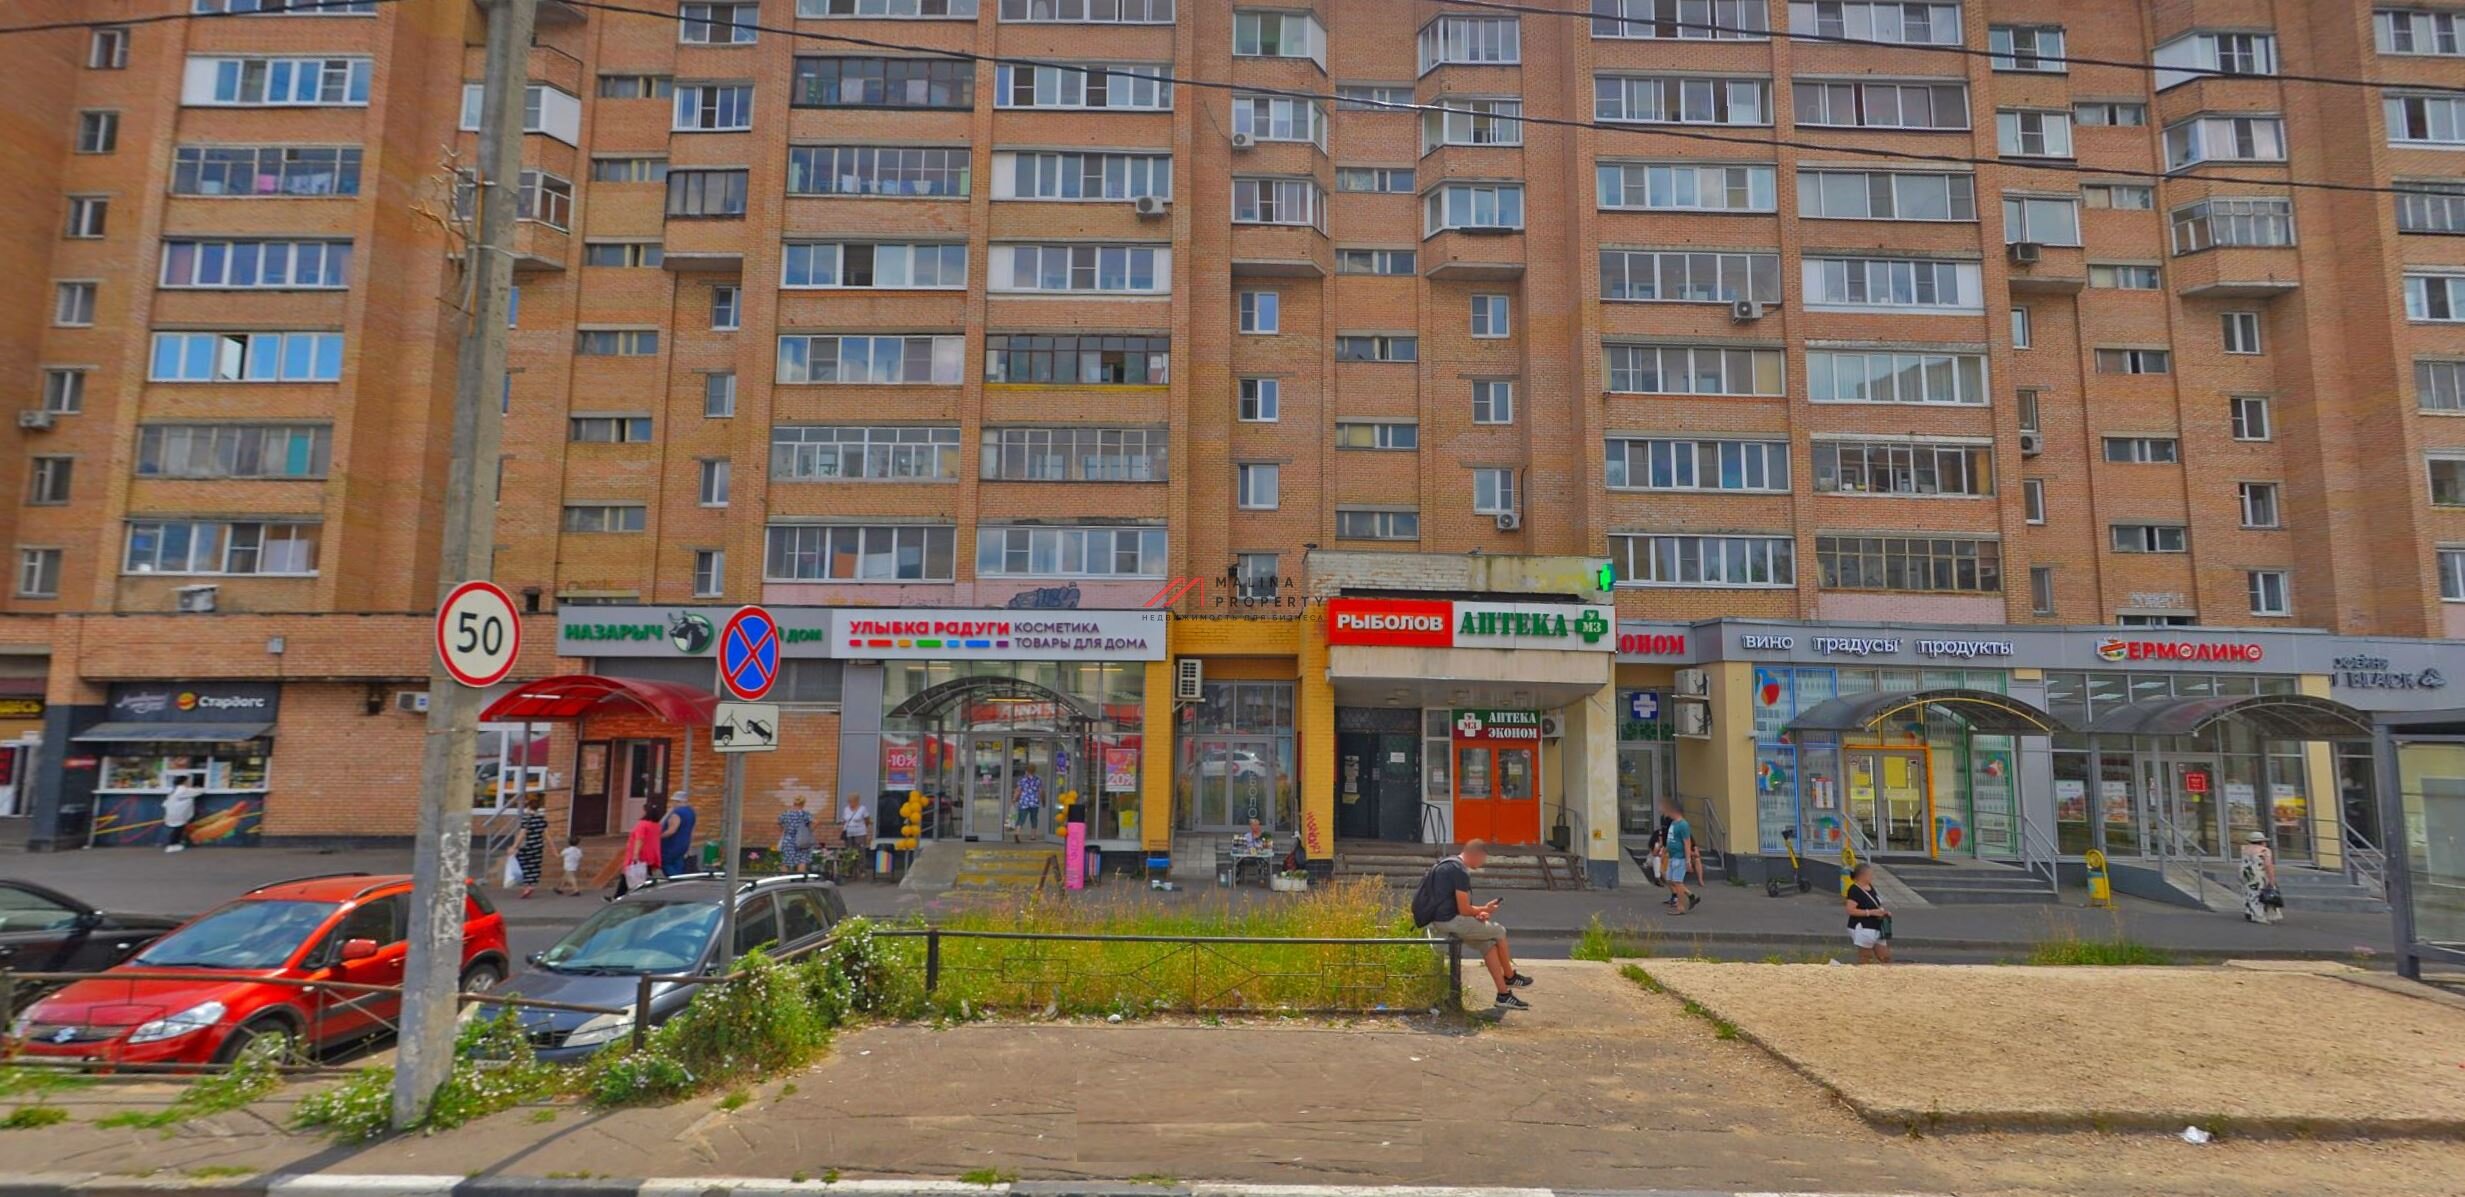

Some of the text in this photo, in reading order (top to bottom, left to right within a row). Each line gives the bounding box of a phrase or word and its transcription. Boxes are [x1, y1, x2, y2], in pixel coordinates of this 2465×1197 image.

[564, 623, 664, 642] НАЗАРЫЧ
[1014, 622, 1100, 634] КОСМЕТИКА
[1337, 614, 1444, 632] РЫБОЛОВ
[1459, 611, 1569, 637] АПТЕКА
[456, 611, 503, 657] 50
[1014, 637, 1148, 650] ТОВАРЫ ДЛЯ ДОМА
[1617, 634, 1685, 655] ОНОМ
[1915, 638, 2015, 658] продукты
[2127, 641, 2264, 663] ЕРМОЛИНО
[1488, 712, 1537, 724] АПТЕКА
[1488, 727, 1537, 739] ЭКОНОМ
